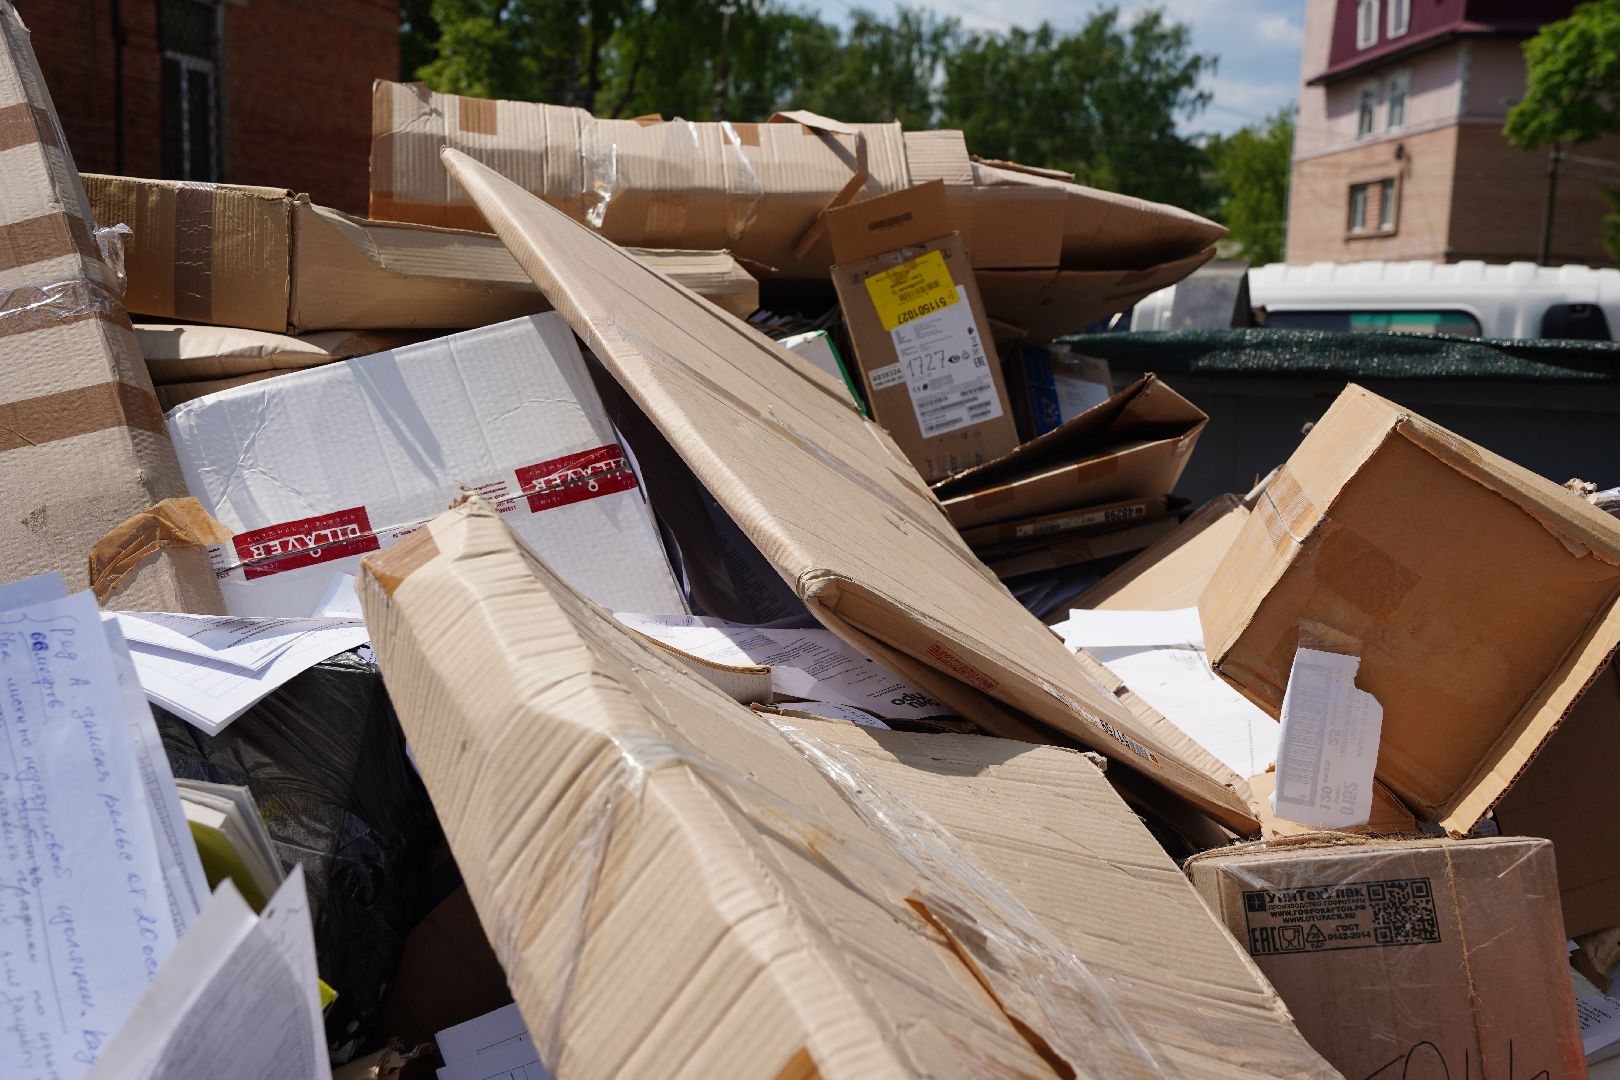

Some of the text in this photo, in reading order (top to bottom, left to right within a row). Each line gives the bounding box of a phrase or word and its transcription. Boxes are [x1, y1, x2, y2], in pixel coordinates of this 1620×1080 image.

[897, 296, 947, 325] 511501027
[906, 349, 945, 378] 1727
[1335, 923, 1360, 932] ГОСТ
